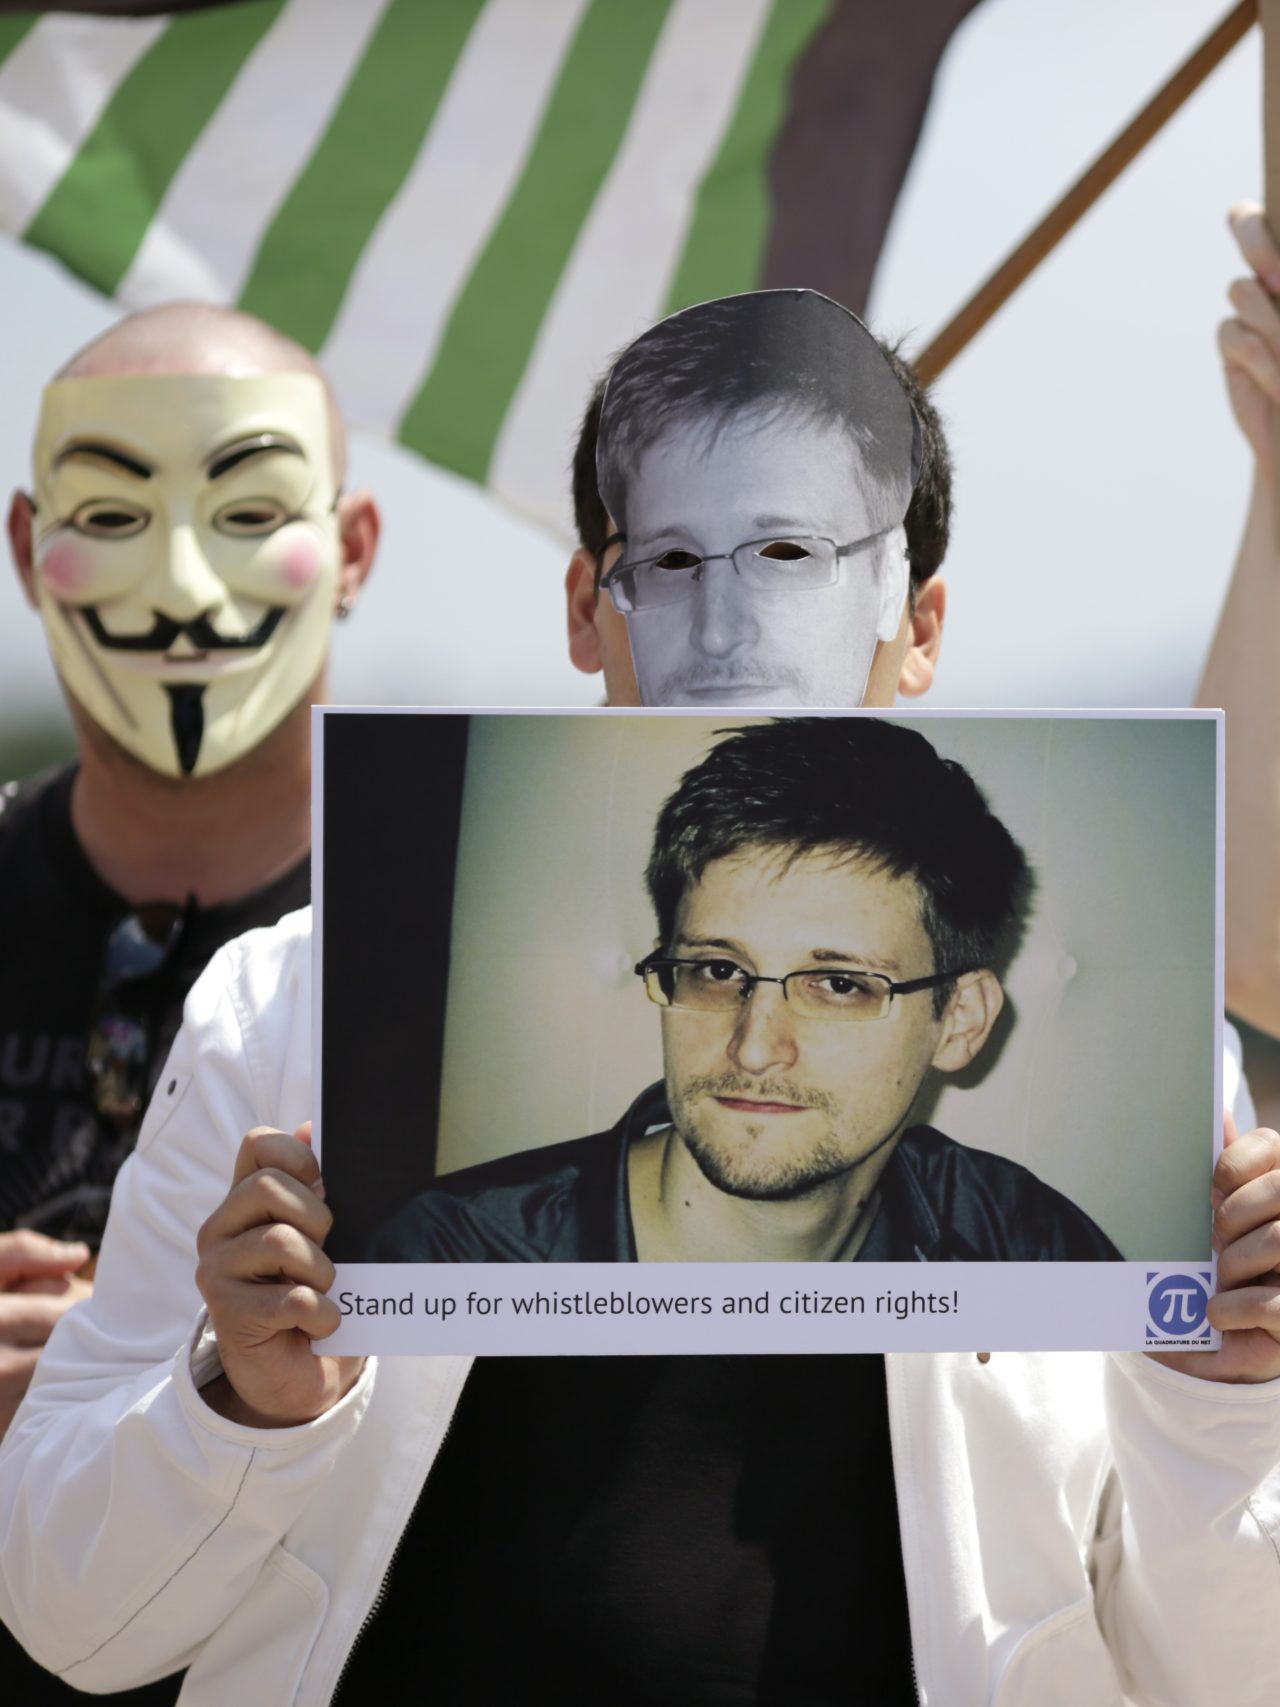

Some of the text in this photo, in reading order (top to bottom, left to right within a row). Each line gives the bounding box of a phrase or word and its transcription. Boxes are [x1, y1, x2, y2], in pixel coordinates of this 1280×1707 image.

[339, 1290, 958, 1321] Stand up for whistleblowers and citizen rights!
